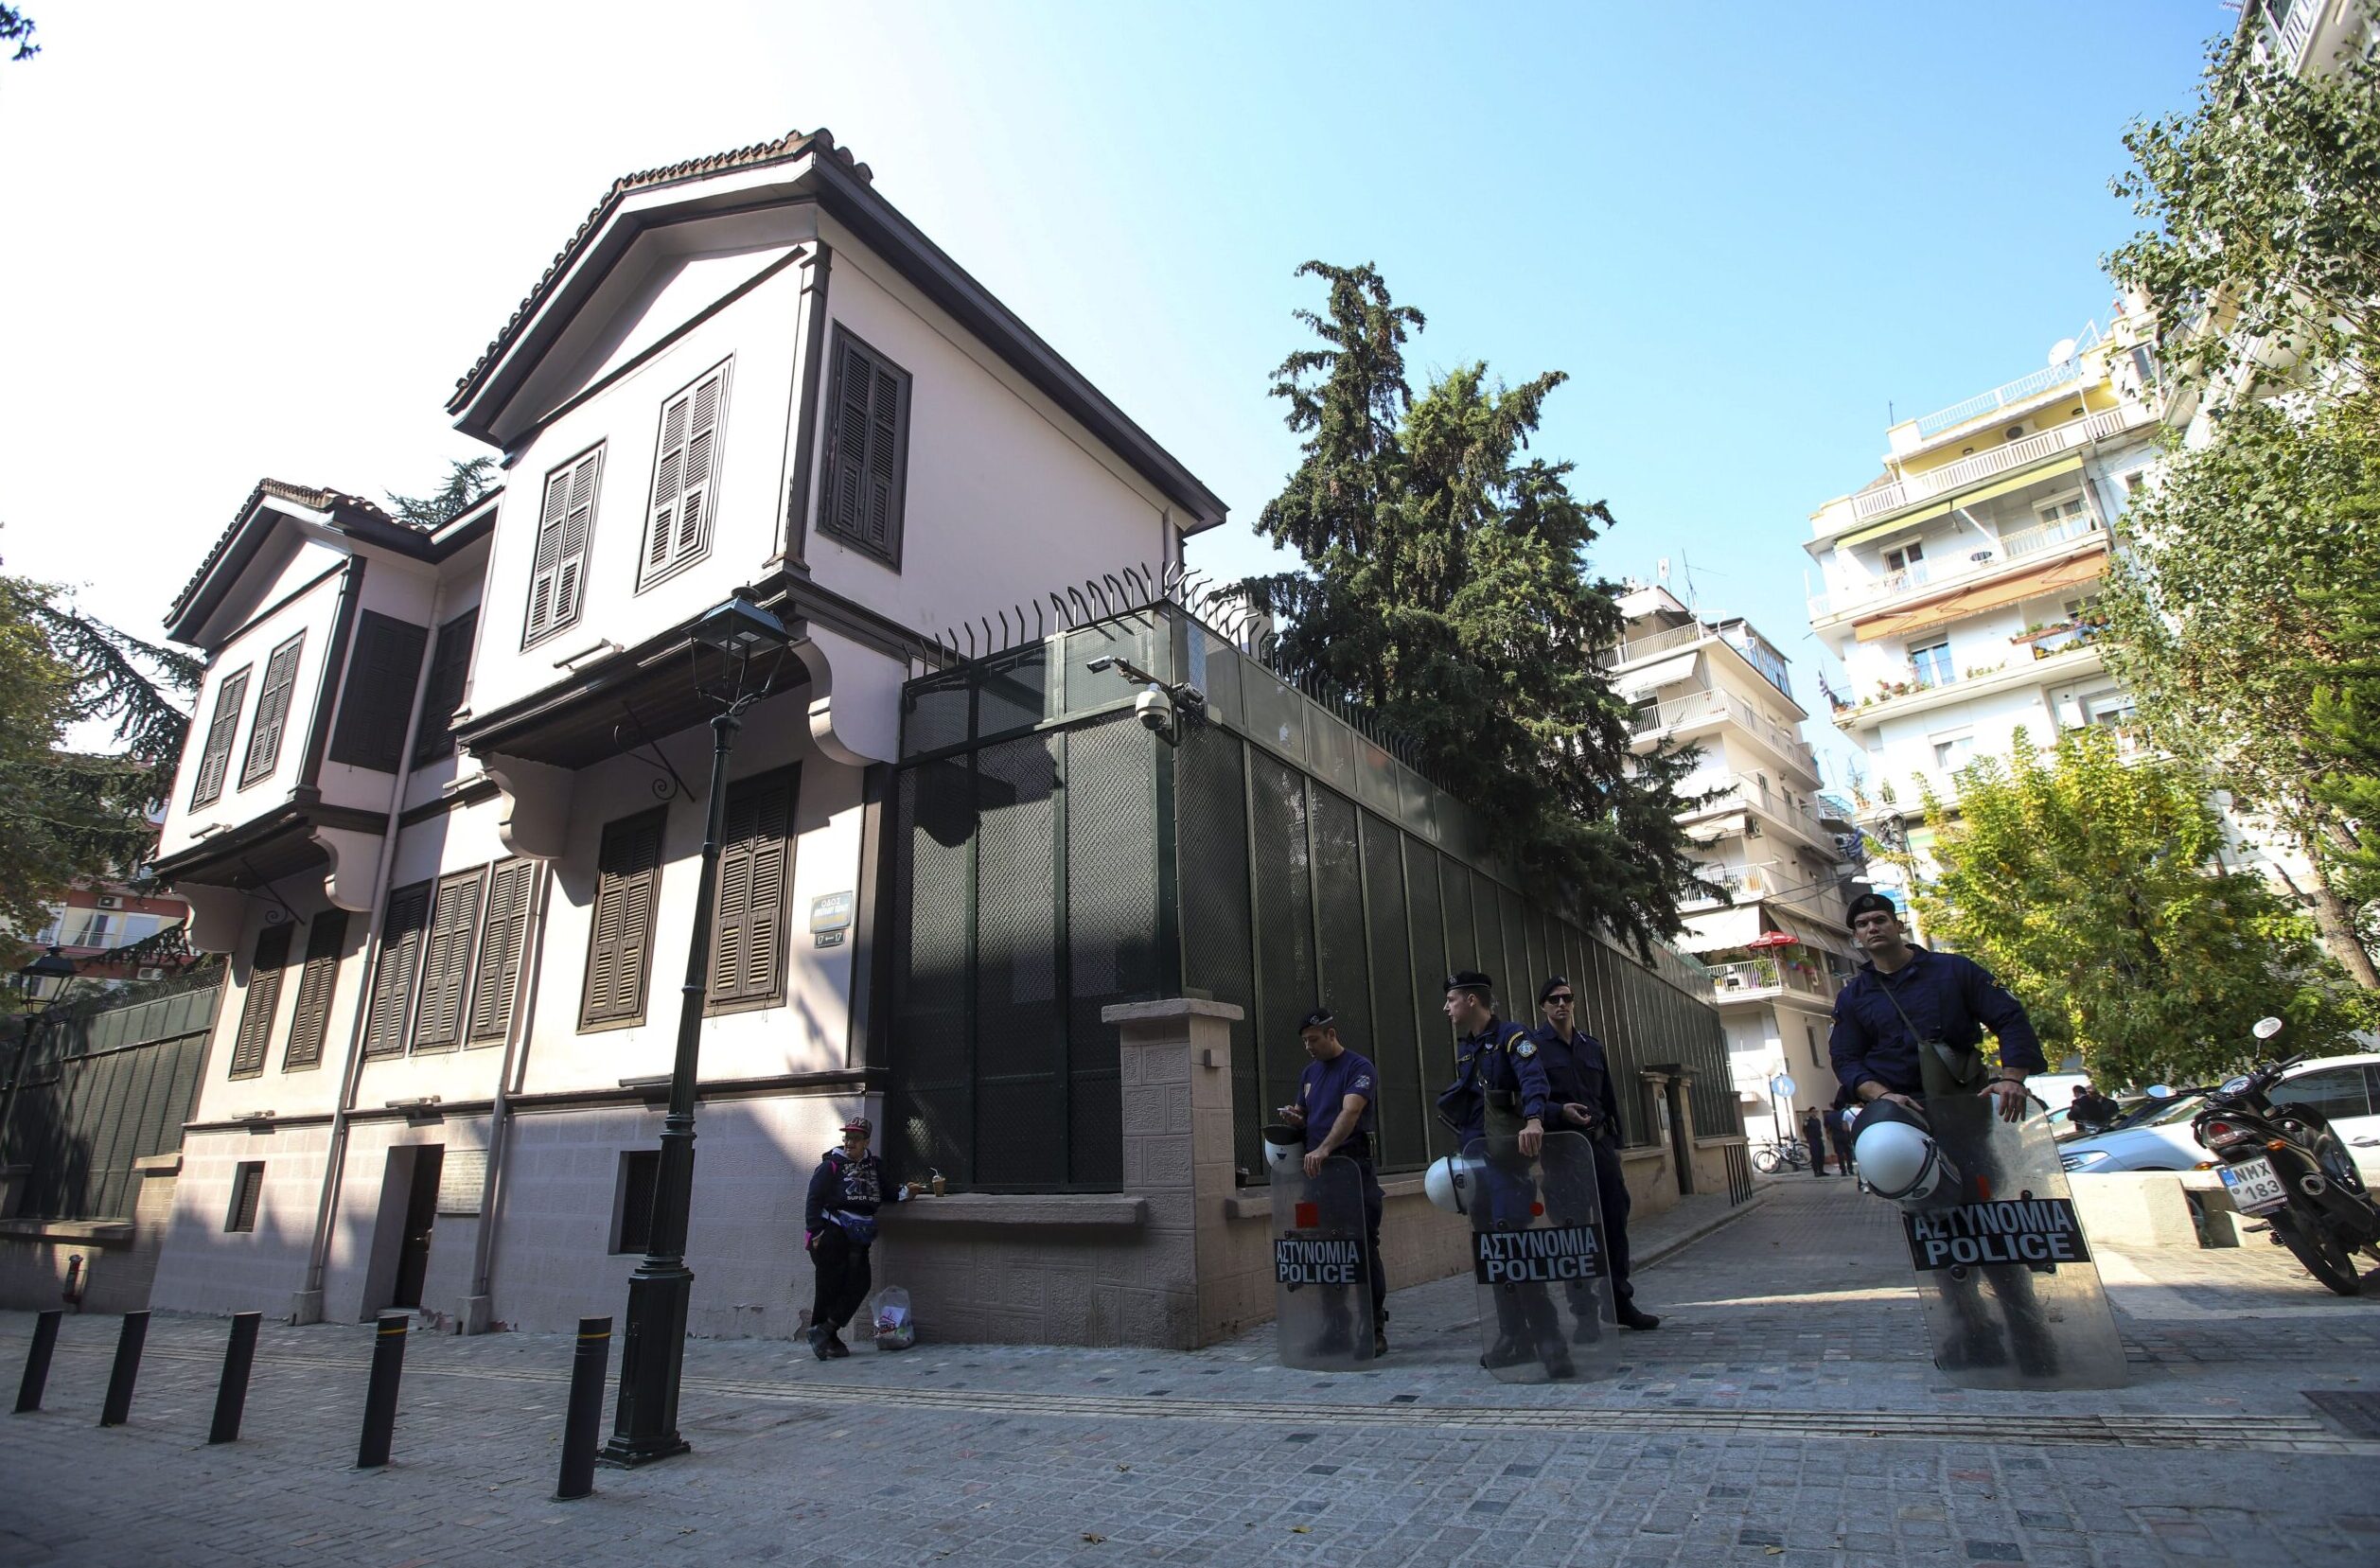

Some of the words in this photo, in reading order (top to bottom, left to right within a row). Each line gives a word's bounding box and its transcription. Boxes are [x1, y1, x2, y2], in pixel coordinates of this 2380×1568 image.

[820, 898, 841, 908] ΟΔΟΣ
[818, 935, 824, 944] 17
[835, 932, 842, 942] 17
[2233, 1161, 2272, 1183] NMX
[2245, 1179, 2280, 1200] 183
[1914, 1200, 2074, 1241] ΑΣΤΥΝΟΜΙΑ
[1277, 1241, 1360, 1264] ΑΣΤΥΝΟΜΙΑ
[1480, 1226, 1599, 1260] ΑΣΤΥΝΟΜΙΑ
[1925, 1232, 2075, 1266] POLICE
[1279, 1263, 1356, 1283] POLICE
[1487, 1254, 1597, 1282] POLICE
